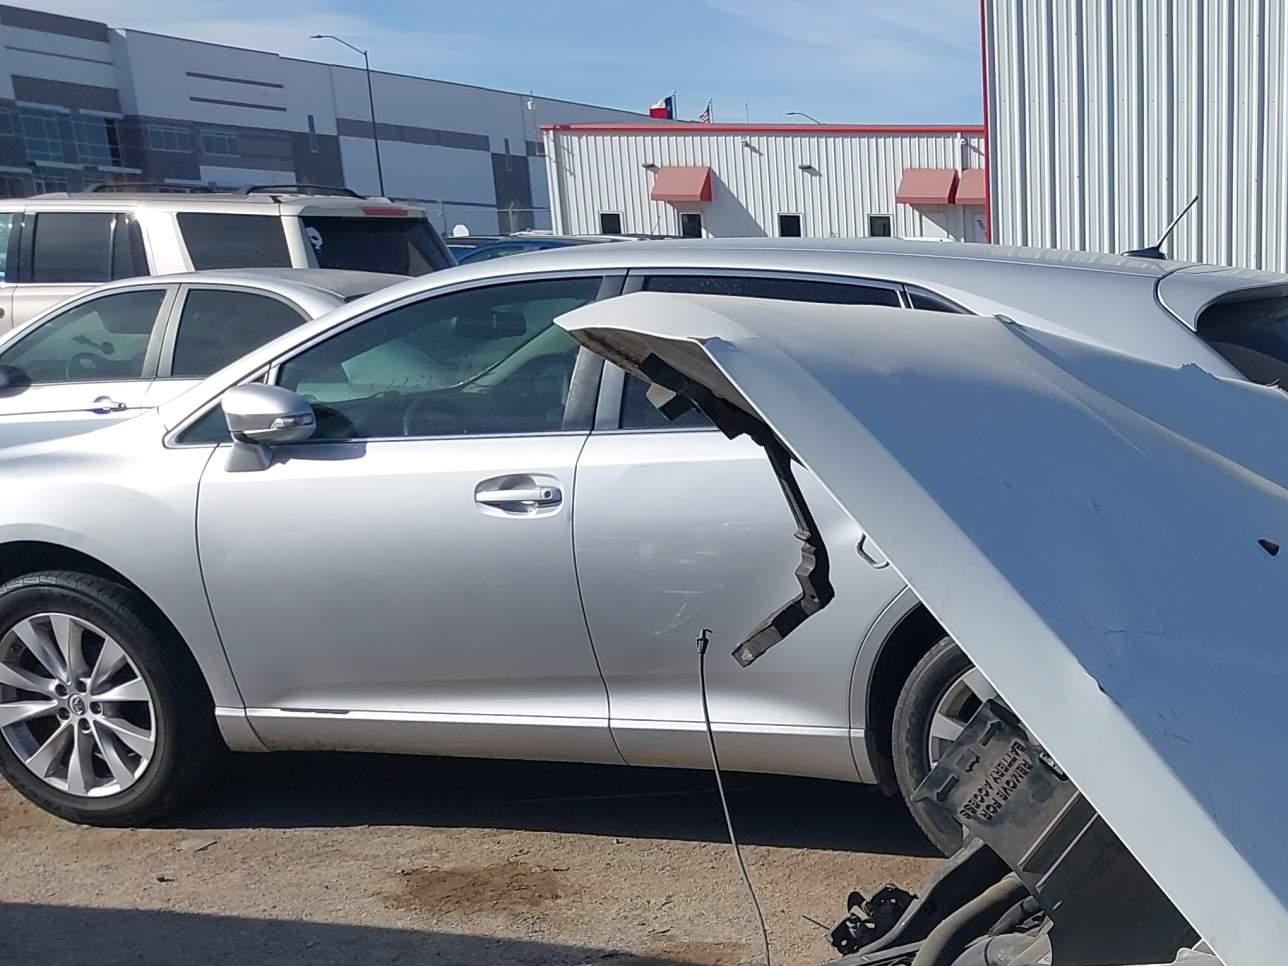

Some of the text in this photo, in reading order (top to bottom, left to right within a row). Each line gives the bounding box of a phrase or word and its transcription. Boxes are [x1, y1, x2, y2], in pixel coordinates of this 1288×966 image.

[959, 740, 1026, 820] BATTERY ACCESS
[979, 758, 1034, 820] REMOVE FOR
